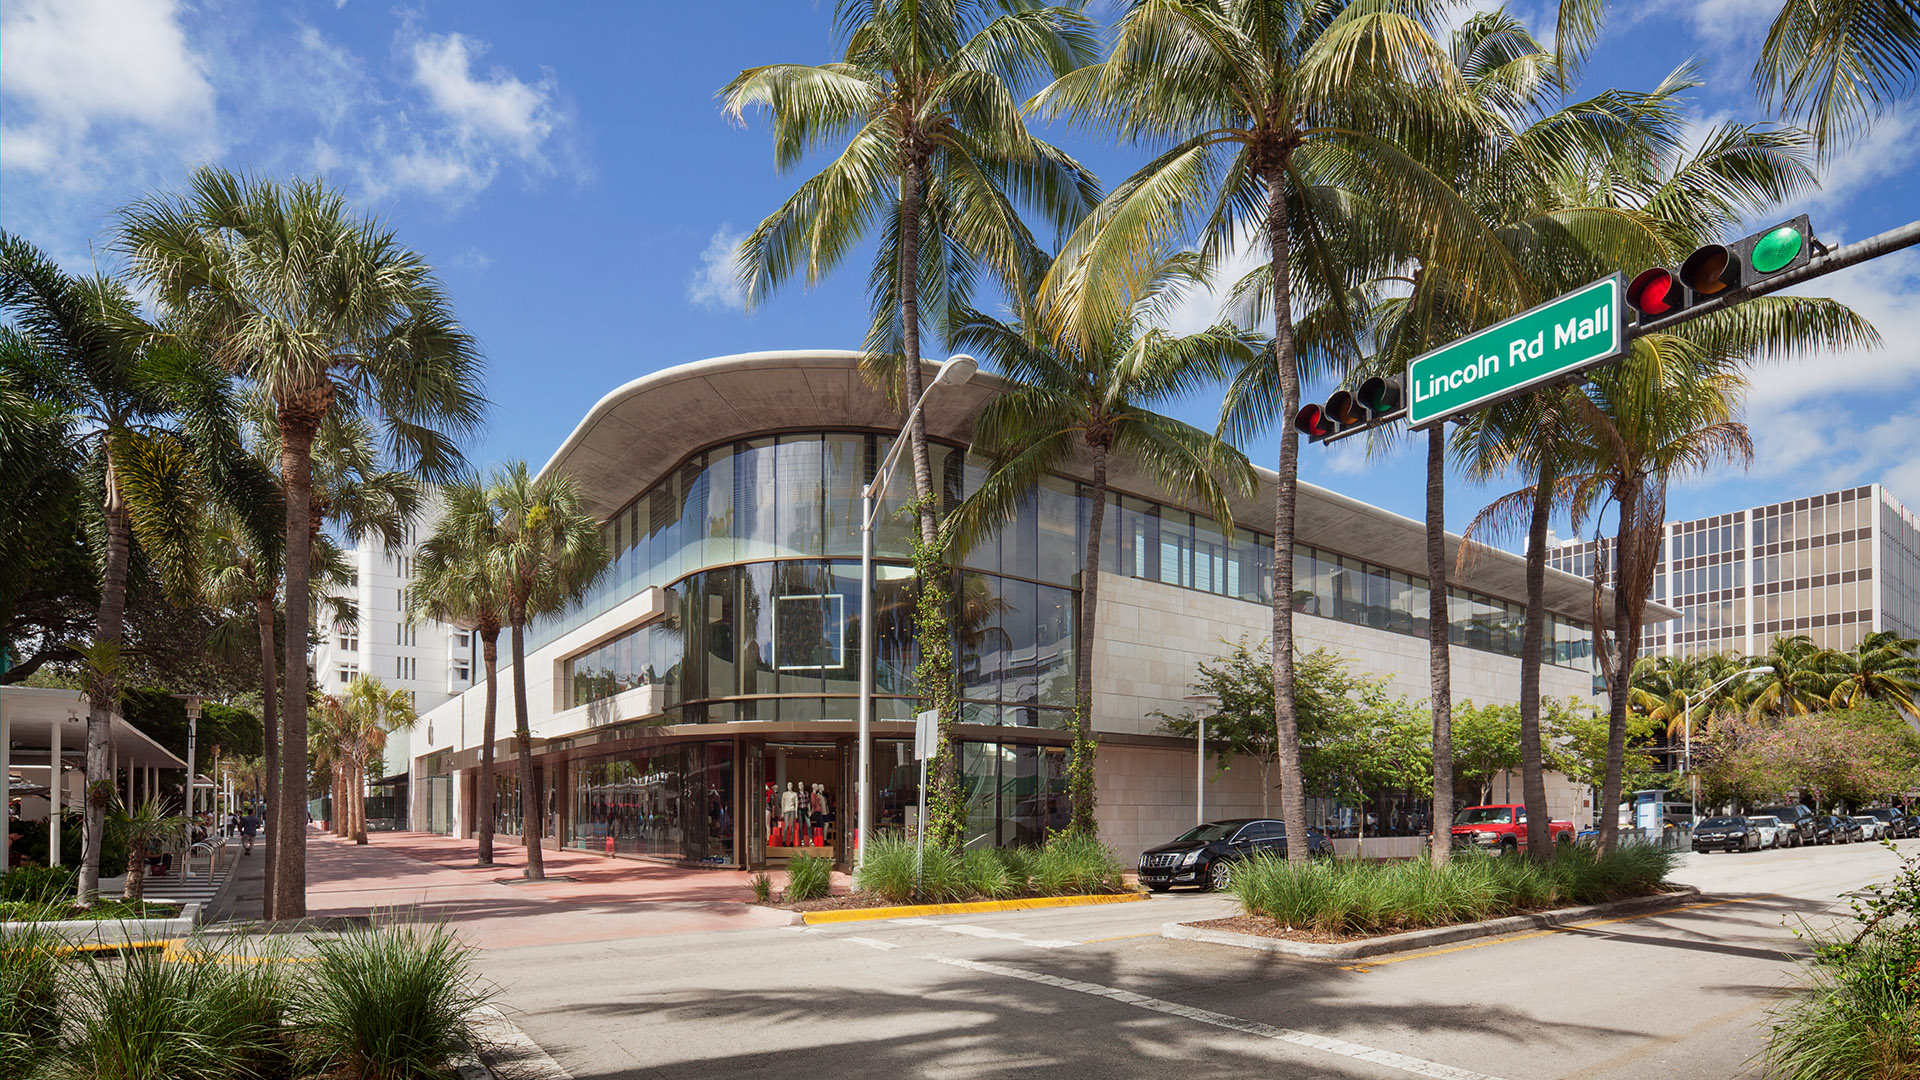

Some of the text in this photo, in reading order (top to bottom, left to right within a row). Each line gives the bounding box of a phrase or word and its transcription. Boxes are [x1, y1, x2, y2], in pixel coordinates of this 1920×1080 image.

[1415, 304, 1609, 403] Lincoln Rd Mall
